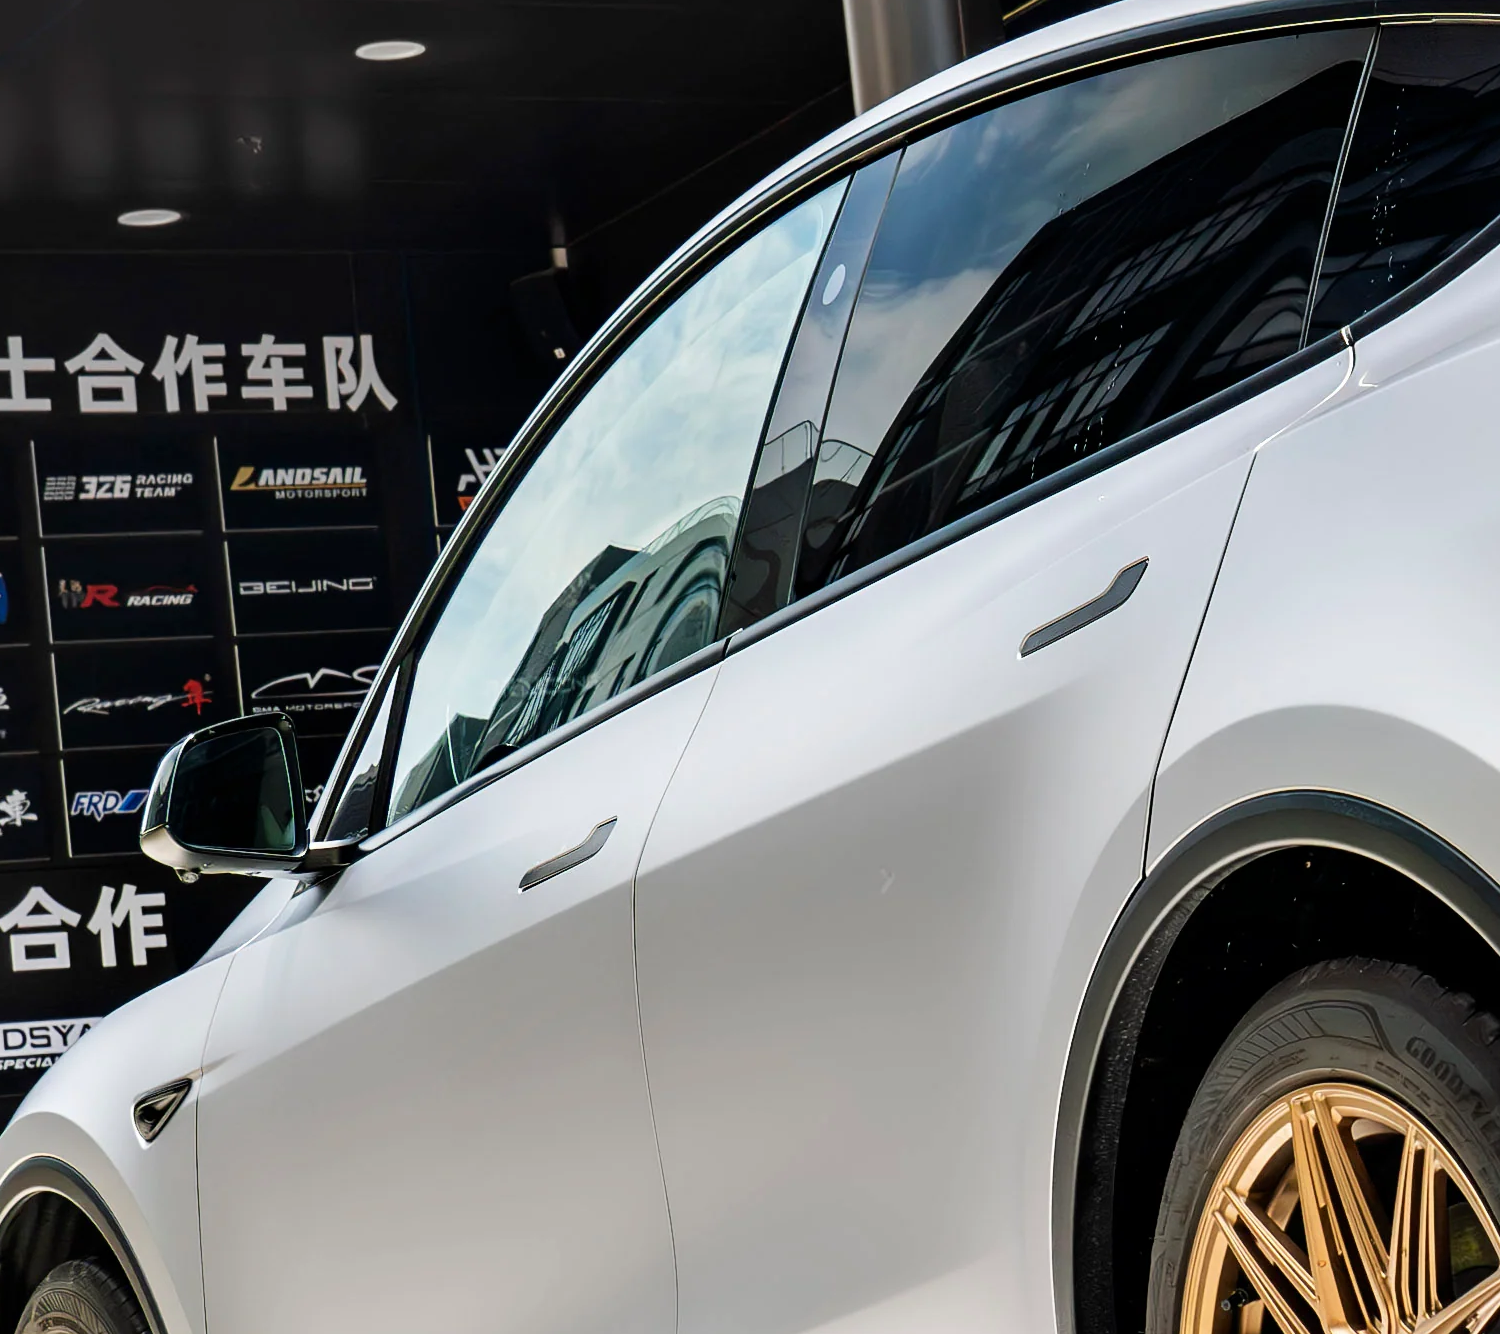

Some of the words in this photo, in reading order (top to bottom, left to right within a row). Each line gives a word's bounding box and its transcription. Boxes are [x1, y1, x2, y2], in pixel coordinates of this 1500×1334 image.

[79, 475, 132, 500] 326
[136, 473, 193, 485] RACING
[230, 466, 367, 491] LANDSAIL
[135, 487, 176, 498] TEAM
[275, 488, 367, 500] MOTORSPORT
[239, 577, 374, 595] BEIJING
[127, 594, 194, 607] RACING
[71, 790, 121, 822] FRD
